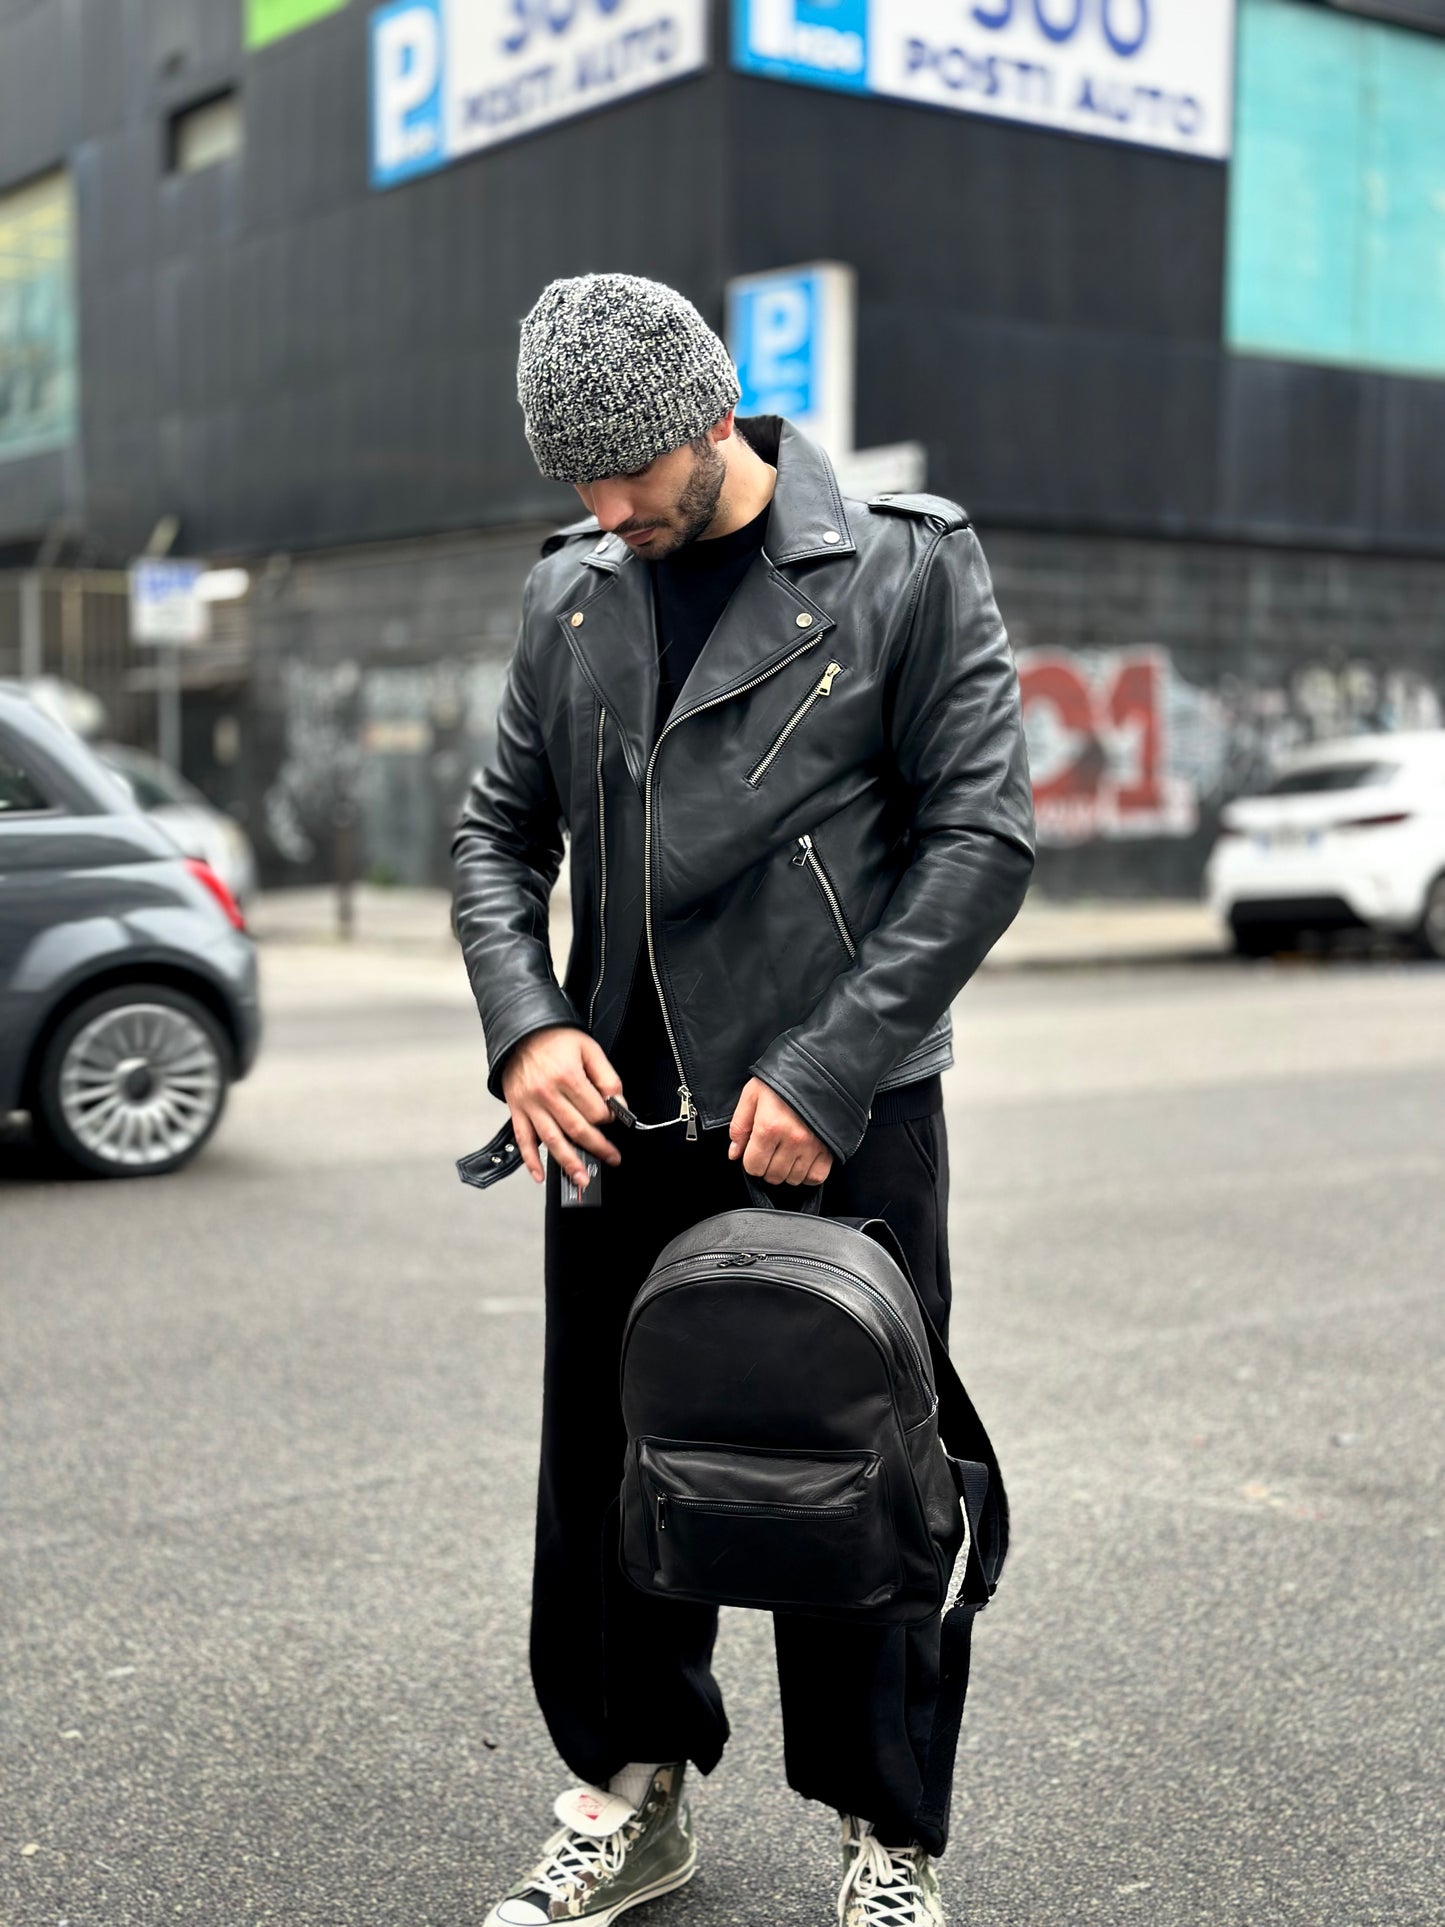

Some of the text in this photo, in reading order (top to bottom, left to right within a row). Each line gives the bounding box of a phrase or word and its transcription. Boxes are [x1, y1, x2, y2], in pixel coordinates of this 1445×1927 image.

[373, 5, 440, 170] P
[463, 62, 558, 130] POSTI
[905, 37, 1205, 137] POSTI AUTO
[752, 288, 808, 386] P
